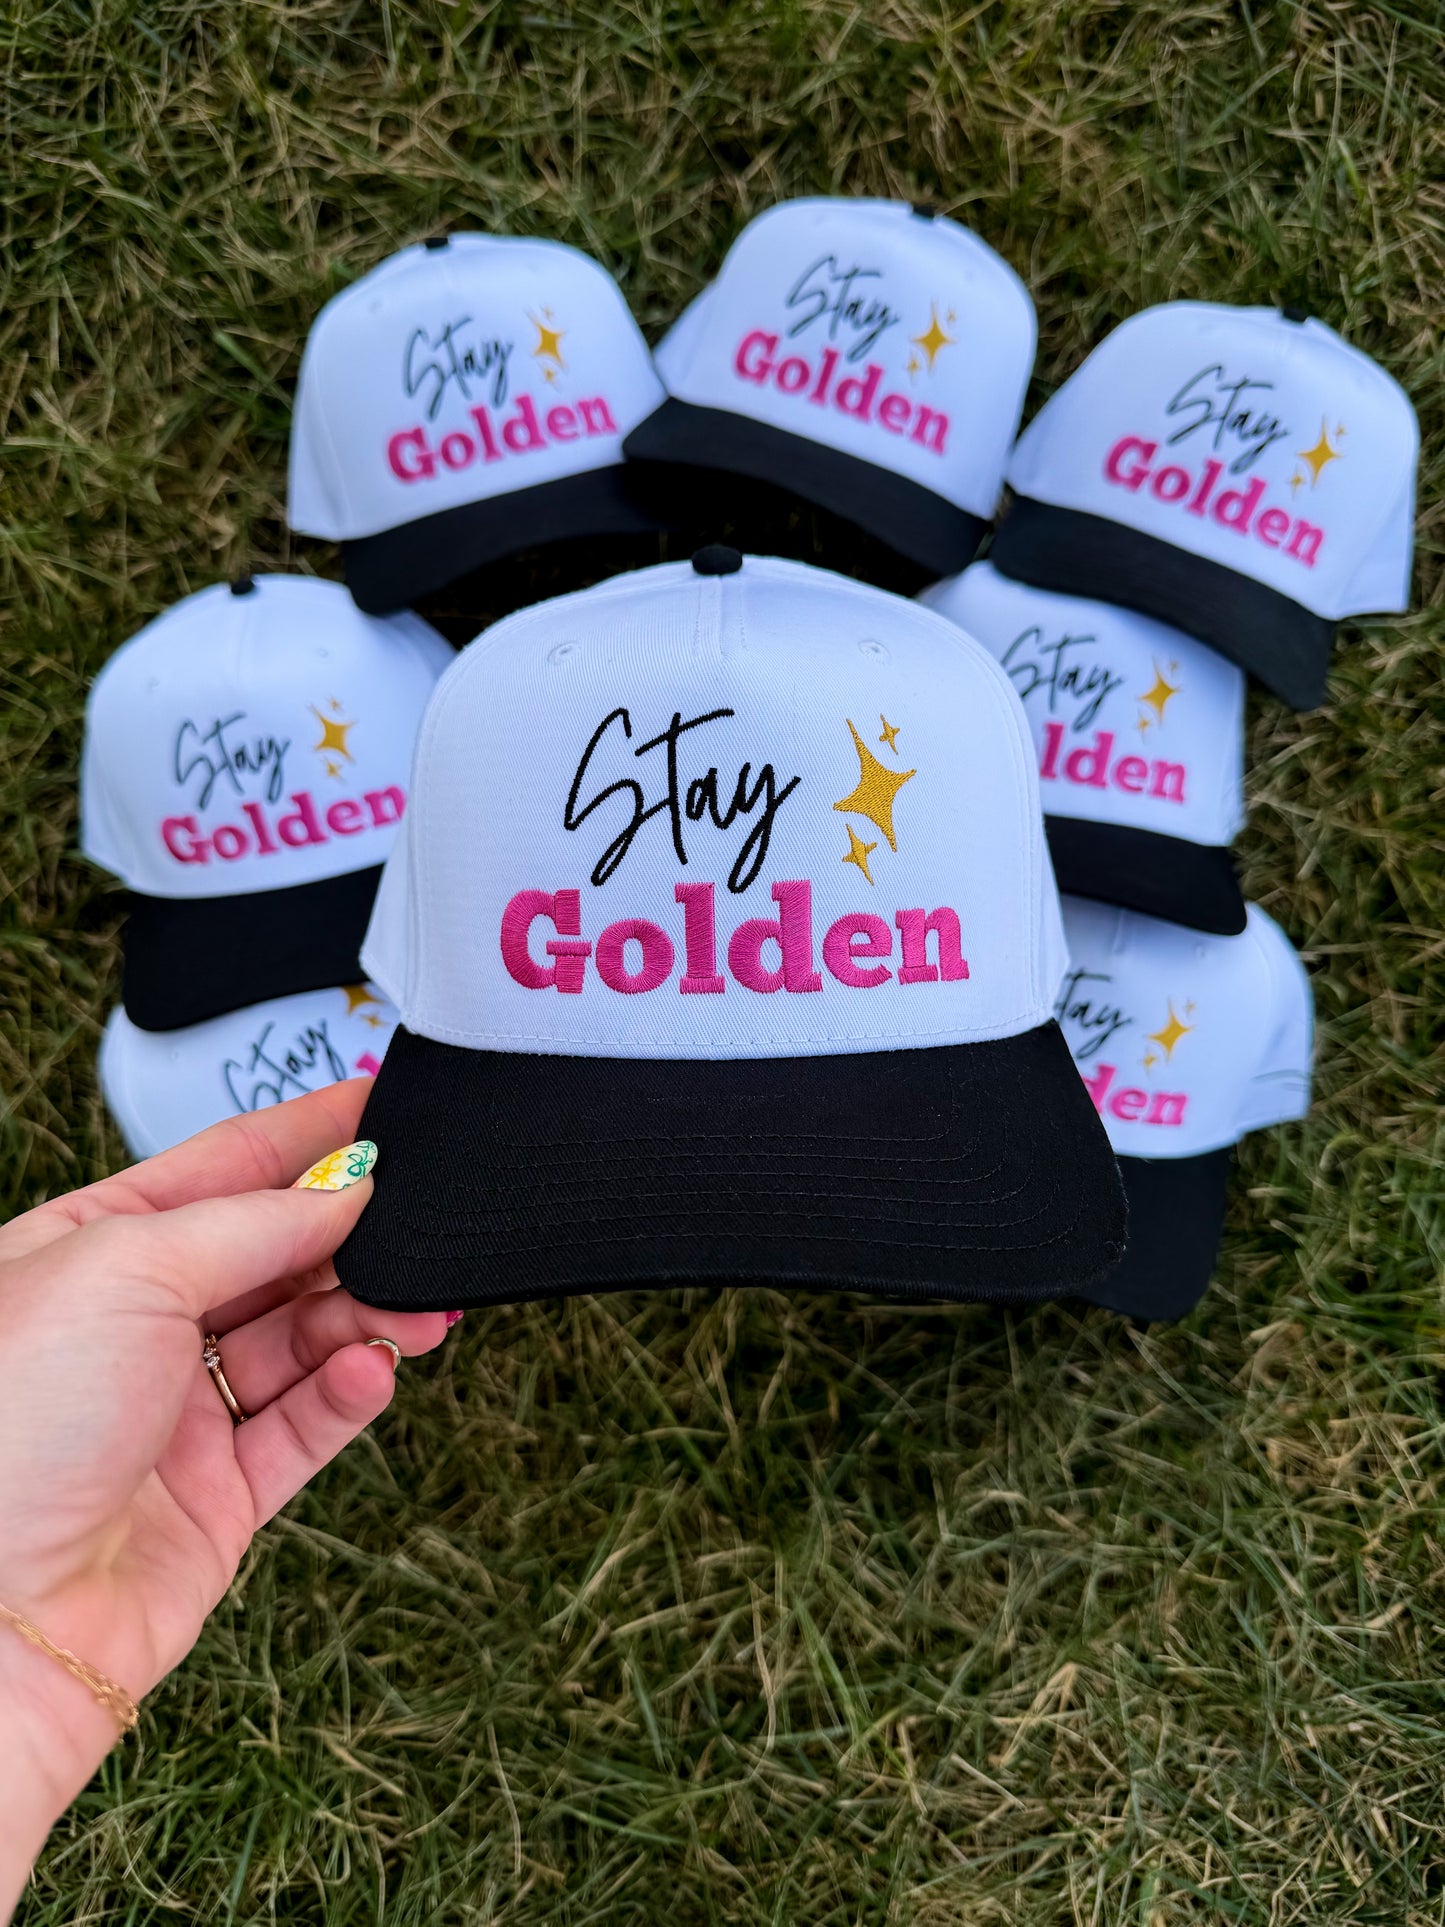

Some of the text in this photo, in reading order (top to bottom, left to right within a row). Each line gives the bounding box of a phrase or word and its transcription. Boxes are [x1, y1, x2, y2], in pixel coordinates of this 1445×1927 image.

[785, 255, 901, 361] Stay
[403, 315, 512, 420] Stay
[734, 329, 951, 456] Golden
[1166, 363, 1291, 475] Stay
[387, 394, 616, 484] Golden
[1104, 435, 1325, 568] Golden
[1001, 625, 1125, 733] Stay
[173, 711, 291, 810] Stay
[564, 707, 801, 893] Stay
[1040, 722, 1187, 805] lden
[161, 785, 407, 864] Golden
[500, 879, 970, 995] Golden
[1054, 968, 1134, 1060] tay
